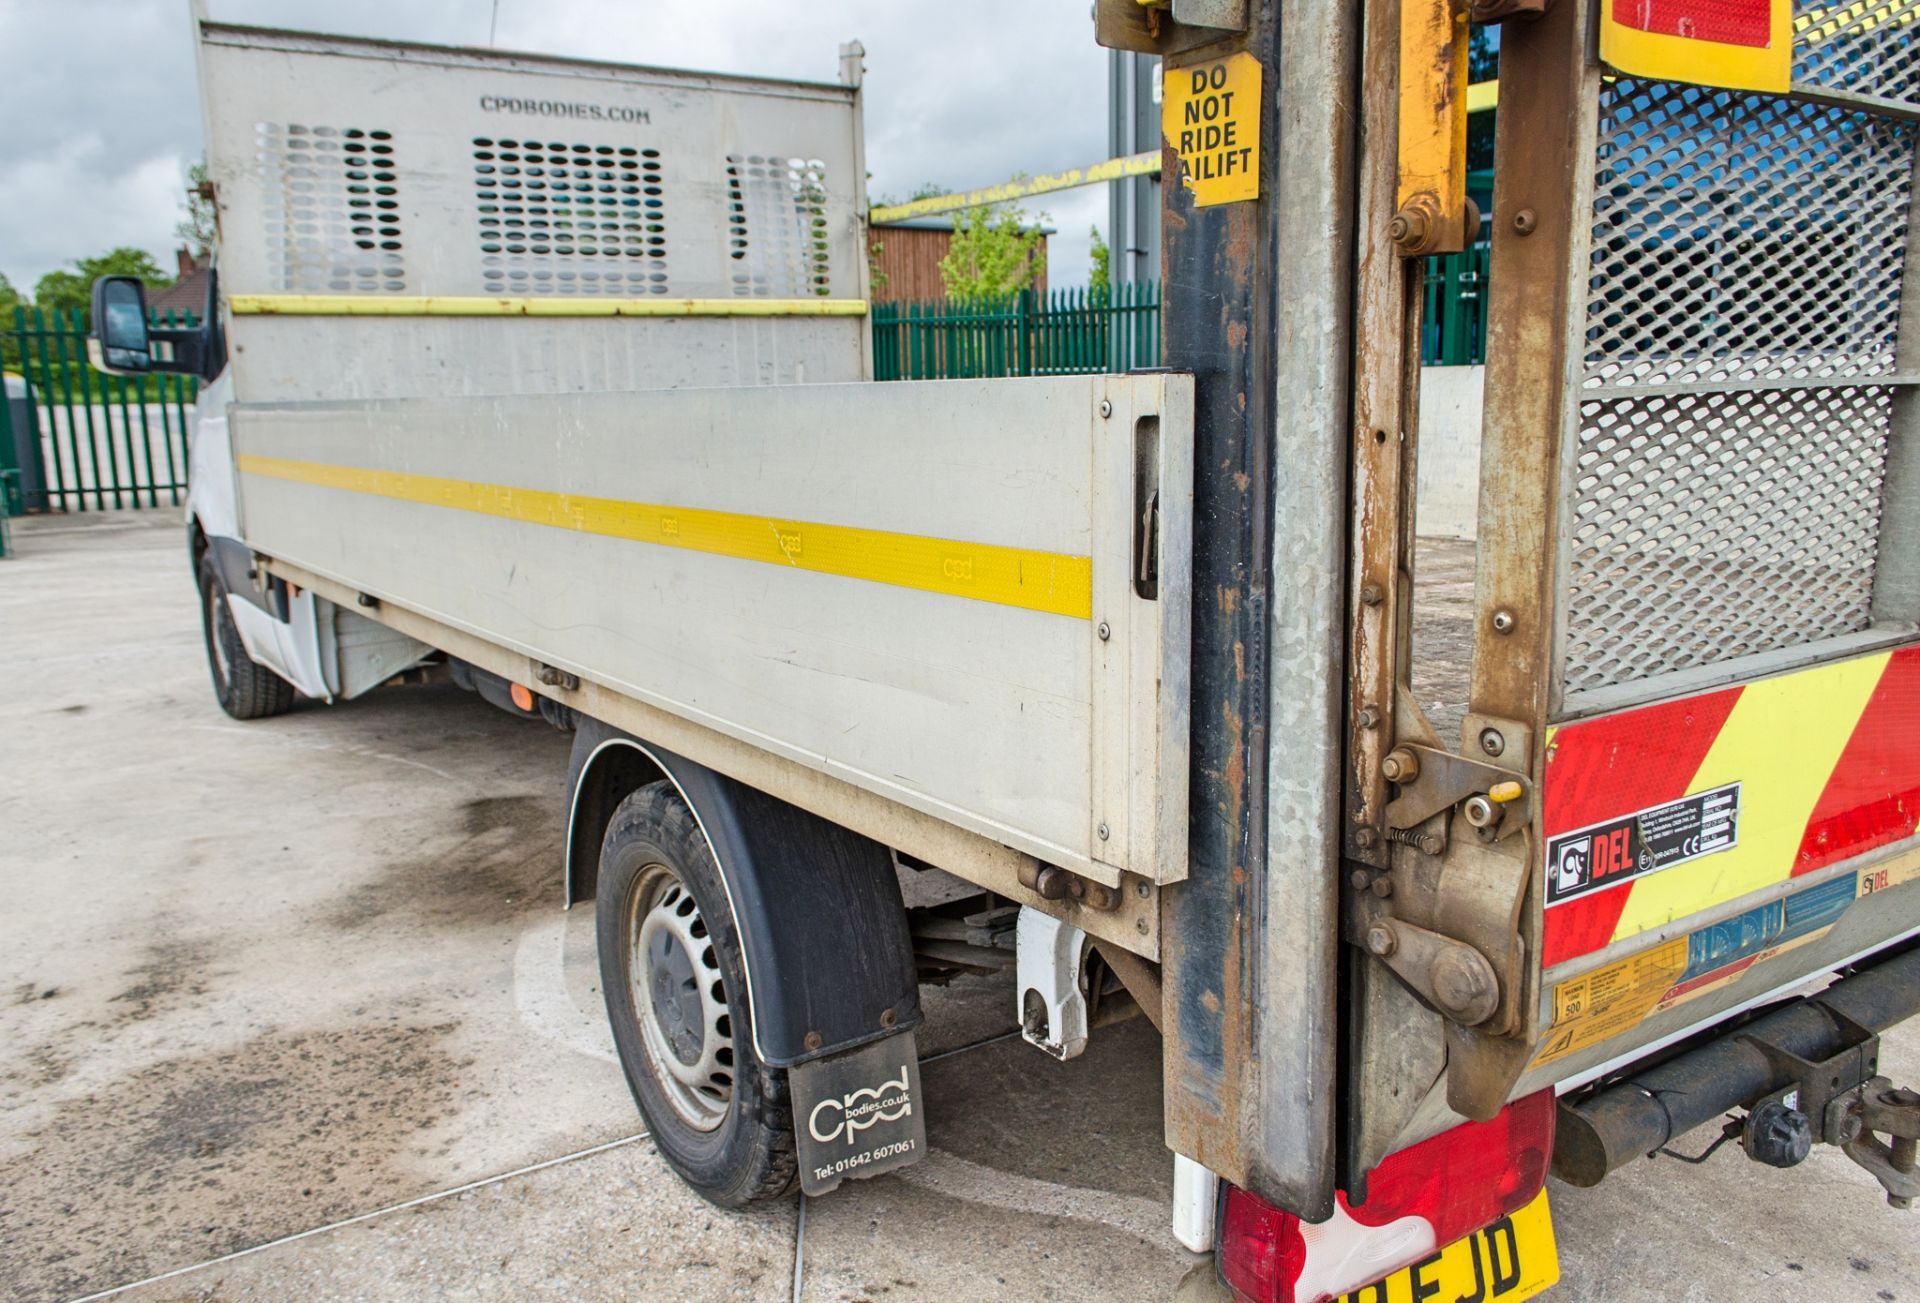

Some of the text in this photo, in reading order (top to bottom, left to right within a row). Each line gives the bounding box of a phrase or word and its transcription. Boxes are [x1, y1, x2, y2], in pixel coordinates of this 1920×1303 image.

[1191, 63, 1227, 95] DO
[479, 94, 652, 125] CPDBODIES.COM
[1184, 91, 1234, 126] NOT
[1180, 121, 1237, 155] RIDE
[1181, 147, 1252, 181] AILIFT
[1592, 827, 1633, 879] DEL
[1683, 835, 1700, 856] CE
[1874, 868, 1889, 890] DEL
[1565, 1001, 1581, 1016] 500
[808, 1064, 912, 1146] cpd
[845, 1092, 911, 1120] bodies.co.uk
[813, 1139, 916, 1180] Tel: 01642 607061
